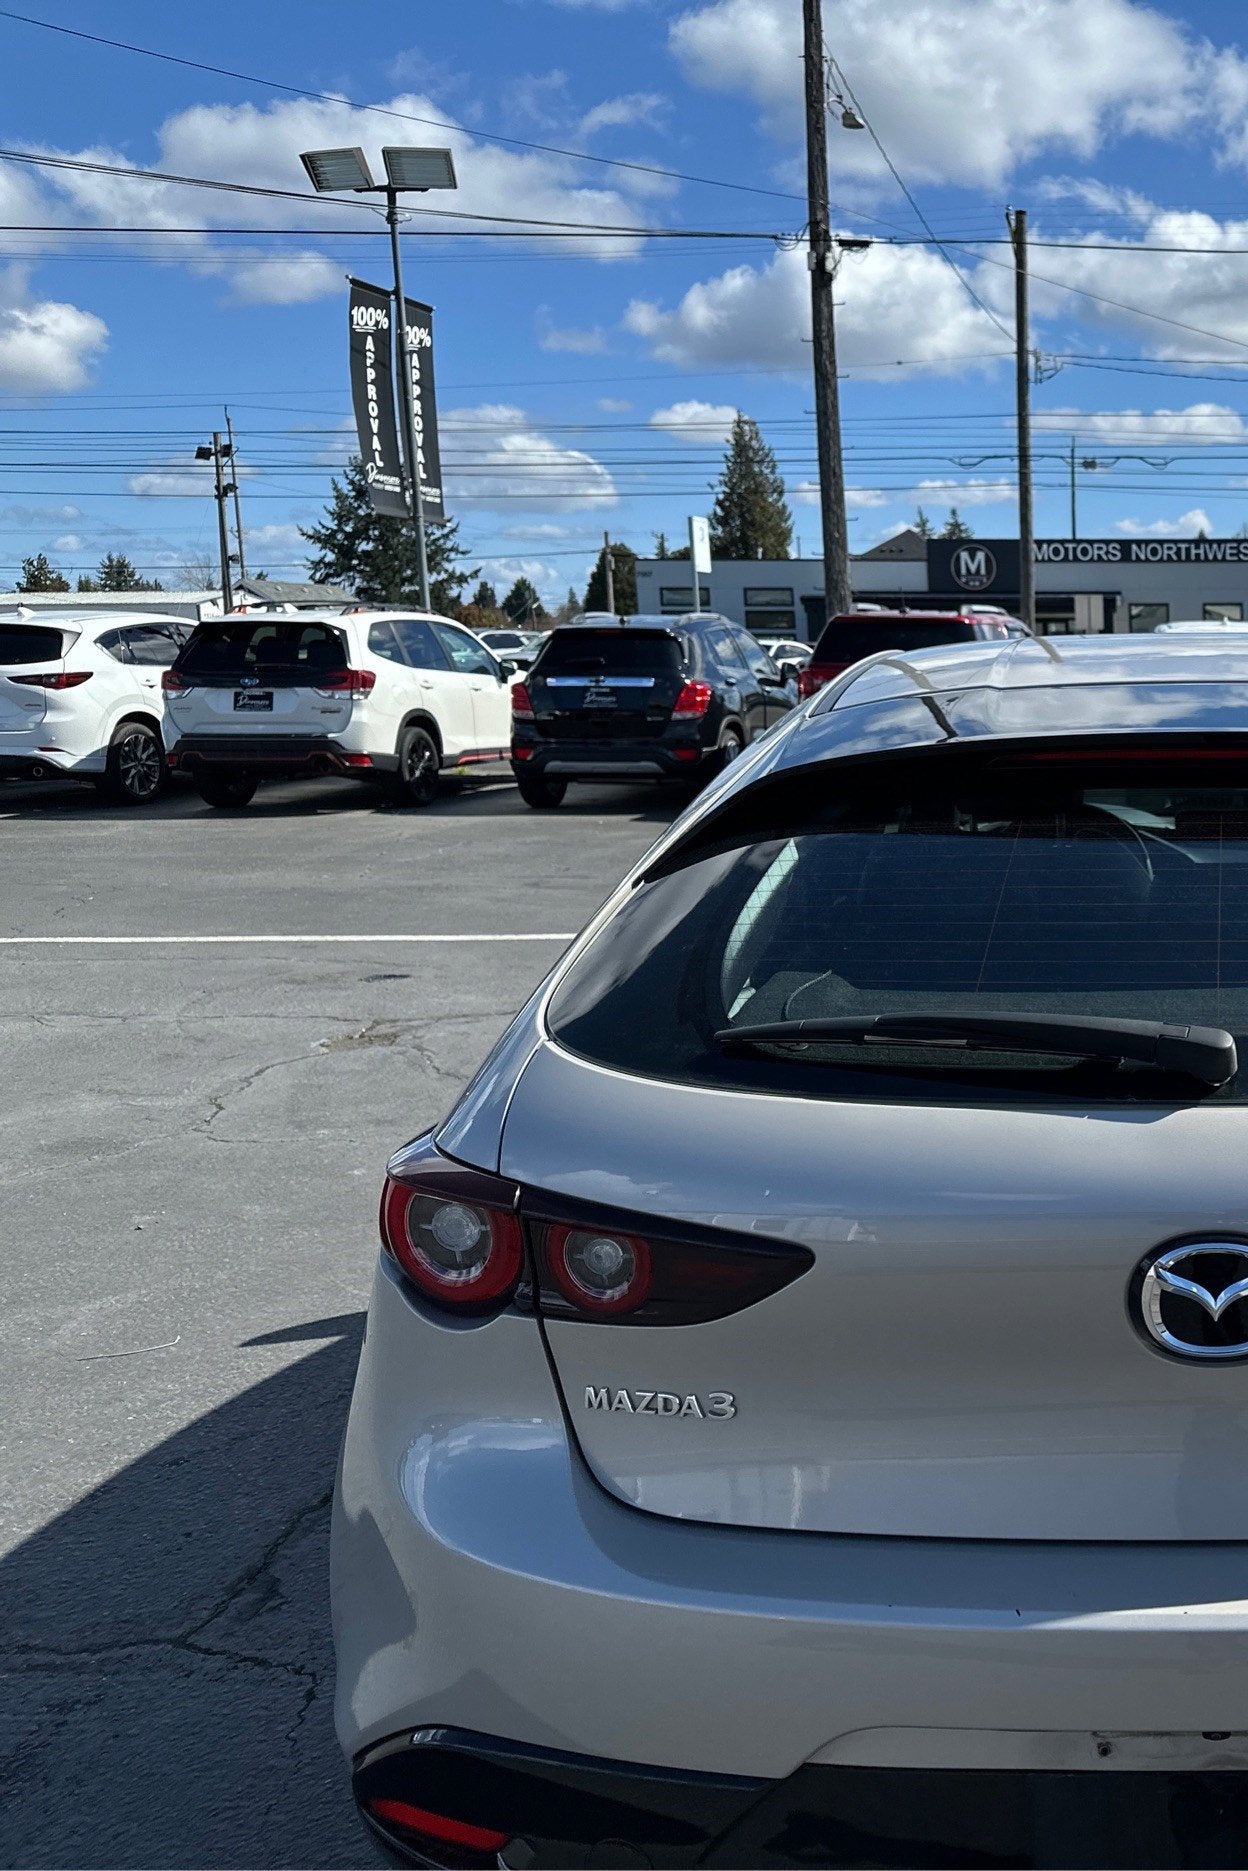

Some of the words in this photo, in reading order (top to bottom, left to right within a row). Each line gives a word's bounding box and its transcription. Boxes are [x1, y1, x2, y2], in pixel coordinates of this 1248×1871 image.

[351, 306, 389, 330] 100%
[405, 325, 432, 348] 00%
[365, 335, 384, 468] APPROVAL
[410, 352, 427, 480] APPROVAL
[960, 550, 986, 576] M
[1032, 542, 1122, 561] MOTORS
